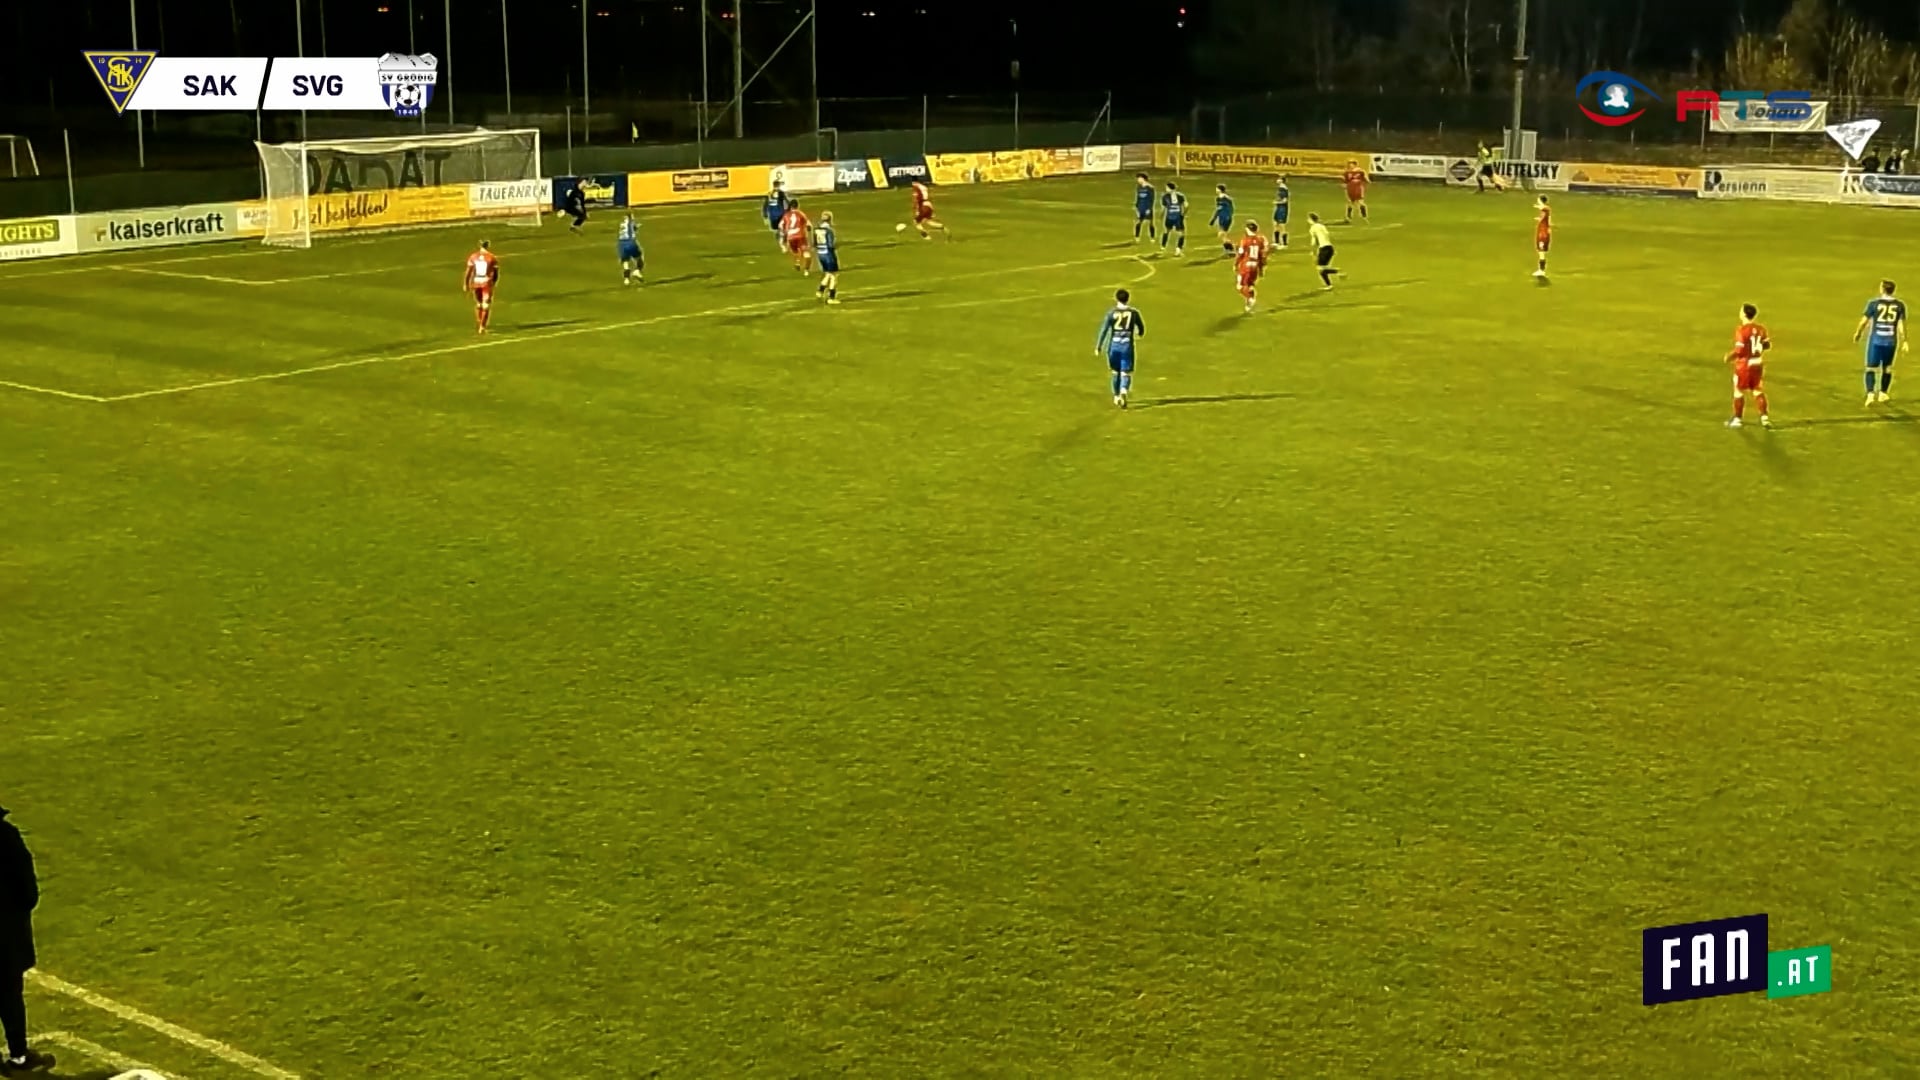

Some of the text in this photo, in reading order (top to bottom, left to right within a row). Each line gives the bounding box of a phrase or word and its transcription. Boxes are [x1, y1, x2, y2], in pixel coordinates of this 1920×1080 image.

[1274, 155, 1298, 167] BAU
[837, 165, 868, 187] Zipfer
[110, 212, 224, 241] kaiserkraft
[1112, 310, 1132, 330] 27
[1876, 304, 1898, 323] 25
